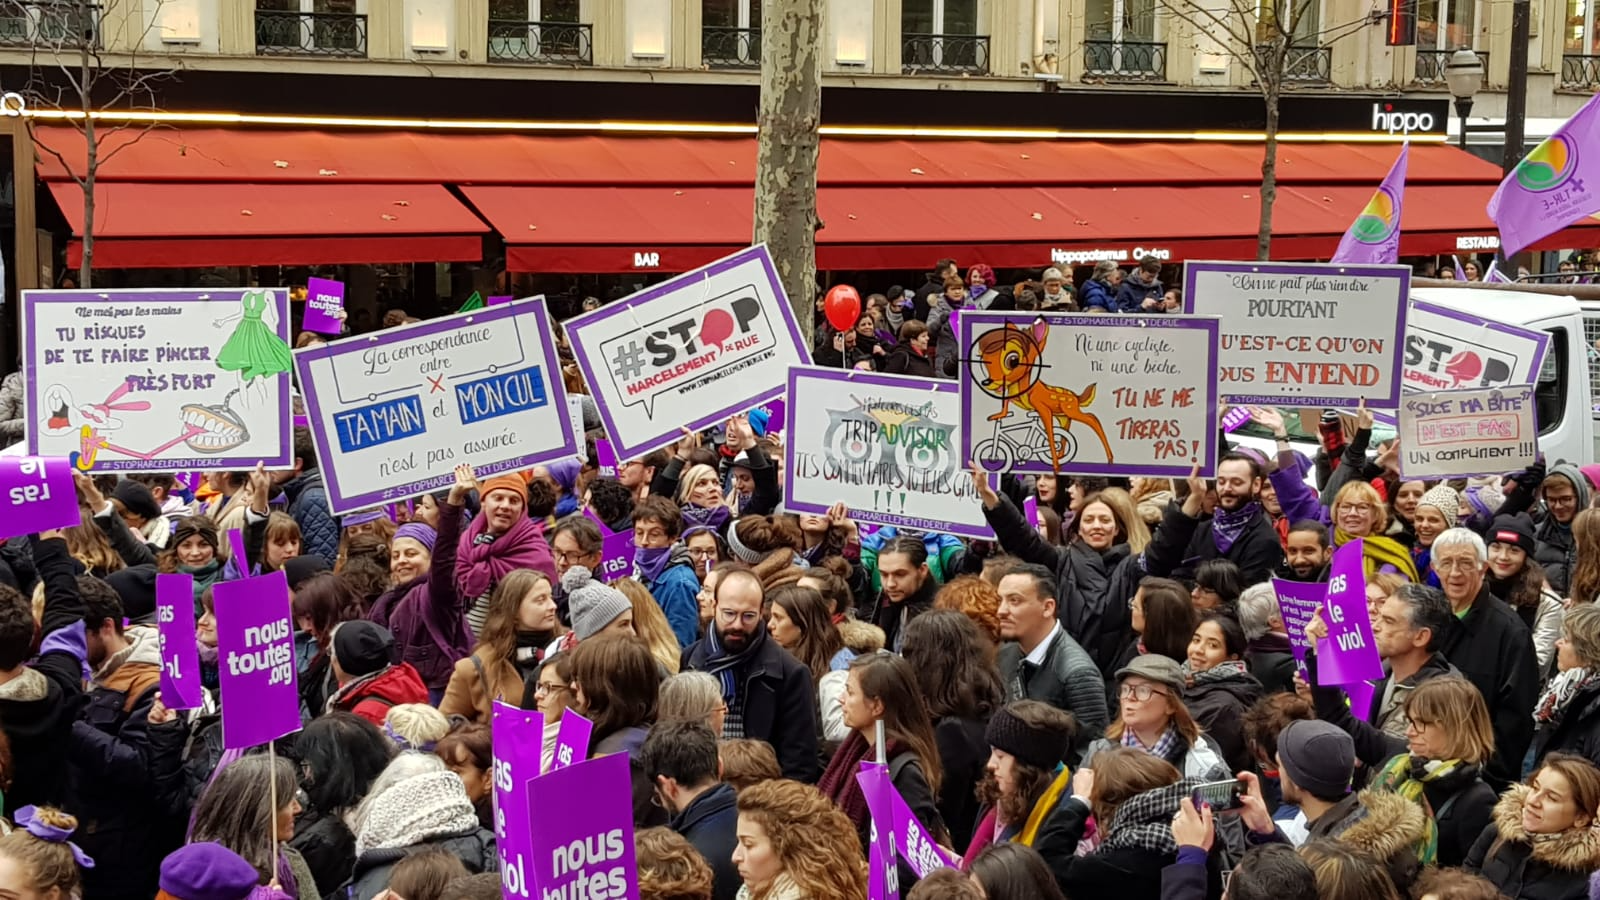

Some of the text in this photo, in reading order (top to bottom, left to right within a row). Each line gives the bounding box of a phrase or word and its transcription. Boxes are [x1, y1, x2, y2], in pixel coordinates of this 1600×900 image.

[1372, 103, 1433, 134] hippo
[634, 253, 660, 267] BAR
[1051, 247, 1127, 263] hippopotamus
[1279, 276, 1303, 293] peut
[1305, 277, 1327, 294] plus
[1329, 279, 1347, 291] rien
[309, 300, 340, 310] toutes
[317, 294, 340, 304] nous
[1247, 299, 1338, 318] POURTANT
[75, 306, 92, 318] Ne
[114, 308, 133, 319] pas
[135, 306, 150, 316] les
[152, 306, 182, 316] mains
[56, 327, 75, 342] TU
[391, 327, 493, 362] correspondance
[735, 334, 760, 351] RUE
[1075, 333, 1094, 355] Ni
[1095, 340, 1121, 353] une
[1315, 336, 1384, 354] QU'ON
[44, 348, 64, 365] DE
[72, 348, 94, 364] TE
[419, 357, 452, 373] entre
[1091, 360, 1104, 373] ni
[1111, 361, 1137, 374] une
[125, 369, 215, 392] TRÈS FORT
[626, 351, 717, 396] HARCELEMENT
[1264, 361, 1380, 387] ENTEND
[457, 372, 543, 421] MON CUL
[1112, 387, 1195, 408] TU NE ME
[1460, 398, 1484, 413] MA
[338, 398, 421, 446] TA MAIN
[842, 419, 948, 450] TRIPADVISOR
[379, 455, 418, 478] n'est
[427, 447, 454, 470] pas
[1409, 451, 1430, 464] UN
[795, 452, 820, 478] TES
[823, 459, 904, 491] COMMENTAIRES
[9, 482, 51, 505] ras
[603, 556, 627, 574] ras
[1328, 574, 1347, 595] ras
[1327, 599, 1345, 623] le
[245, 618, 289, 647] nous
[1336, 623, 1365, 652] viol
[227, 642, 291, 676] toutes
[268, 665, 292, 686] .org
[557, 742, 573, 765] ras
[553, 829, 624, 878] nous
[501, 848, 528, 898] iol
